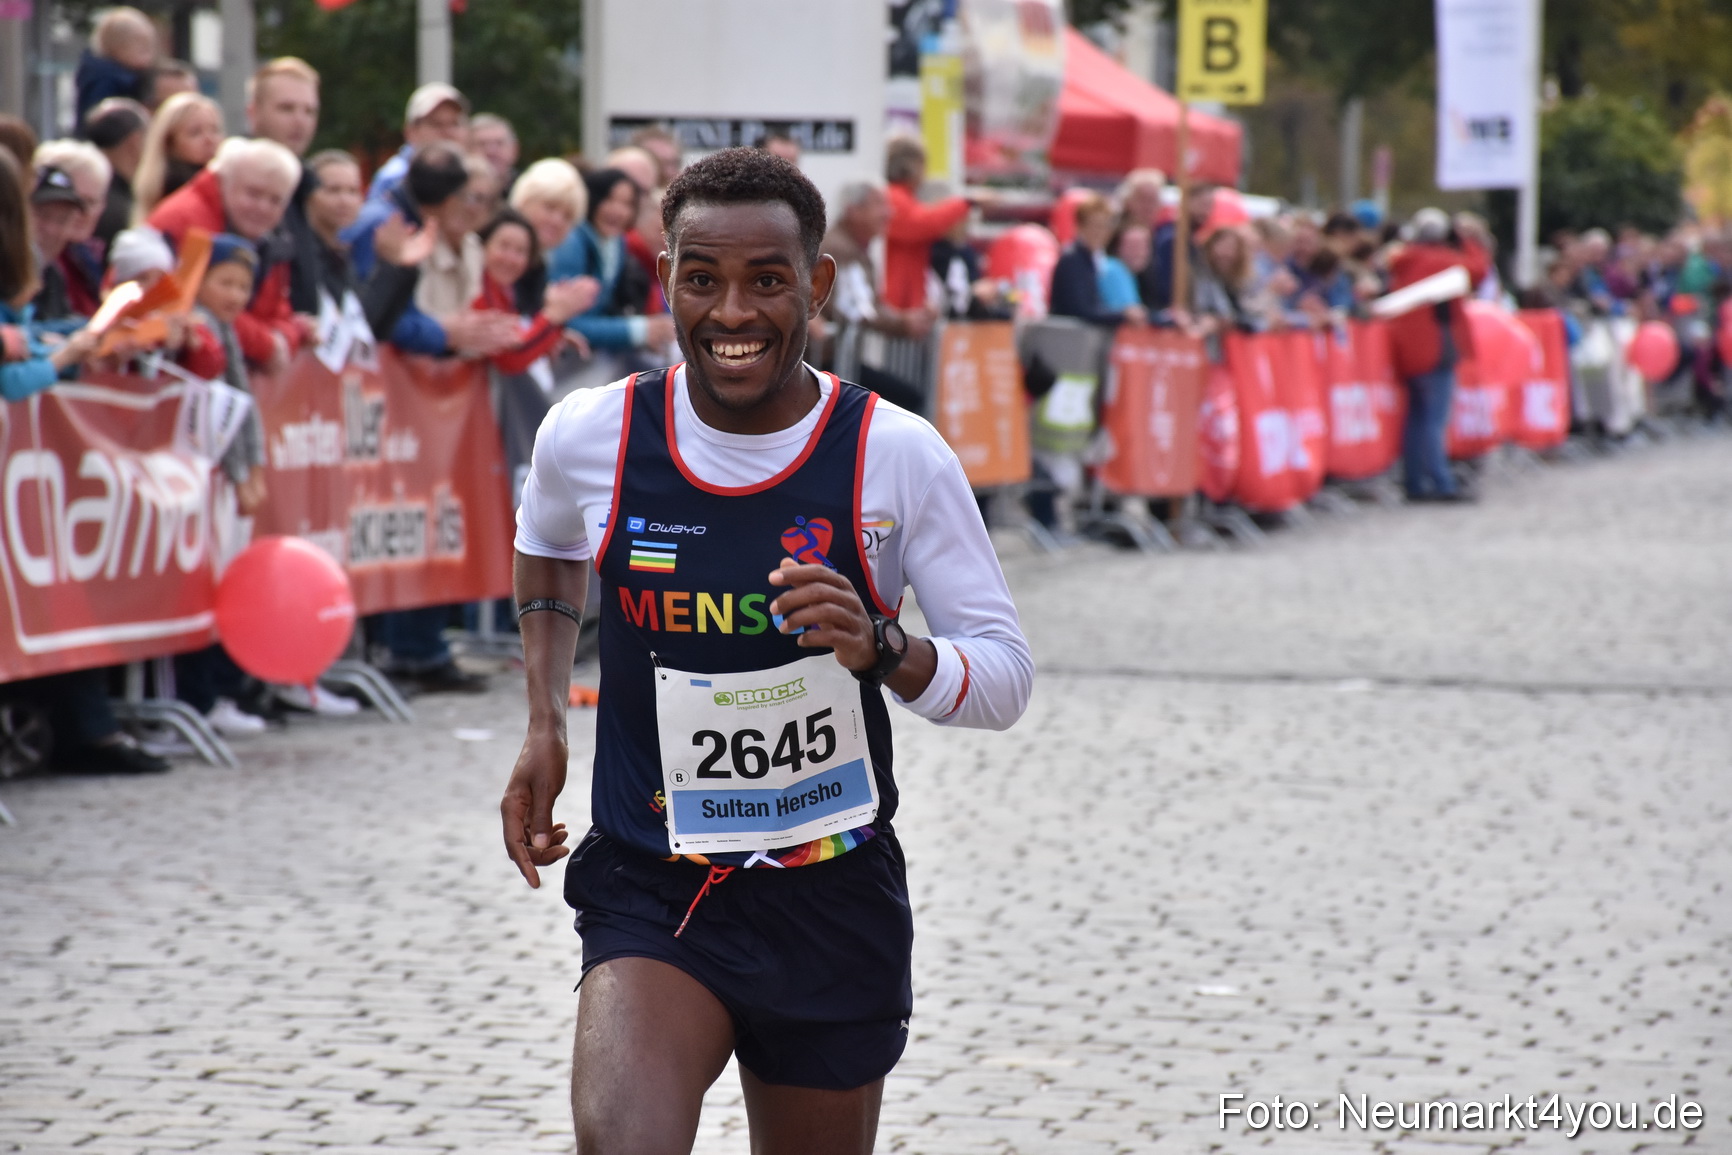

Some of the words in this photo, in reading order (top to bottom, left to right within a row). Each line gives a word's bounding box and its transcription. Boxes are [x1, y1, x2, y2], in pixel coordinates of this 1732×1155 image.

[1203, 16, 1240, 73] B
[735, 677, 807, 705] BOCK
[737, 703, 759, 711] inspired
[786, 692, 808, 704] concepts
[692, 707, 836, 779] 2645
[675, 773, 684, 782] B
[701, 800, 769, 819] Sultan
[776, 781, 843, 818] Hersho
